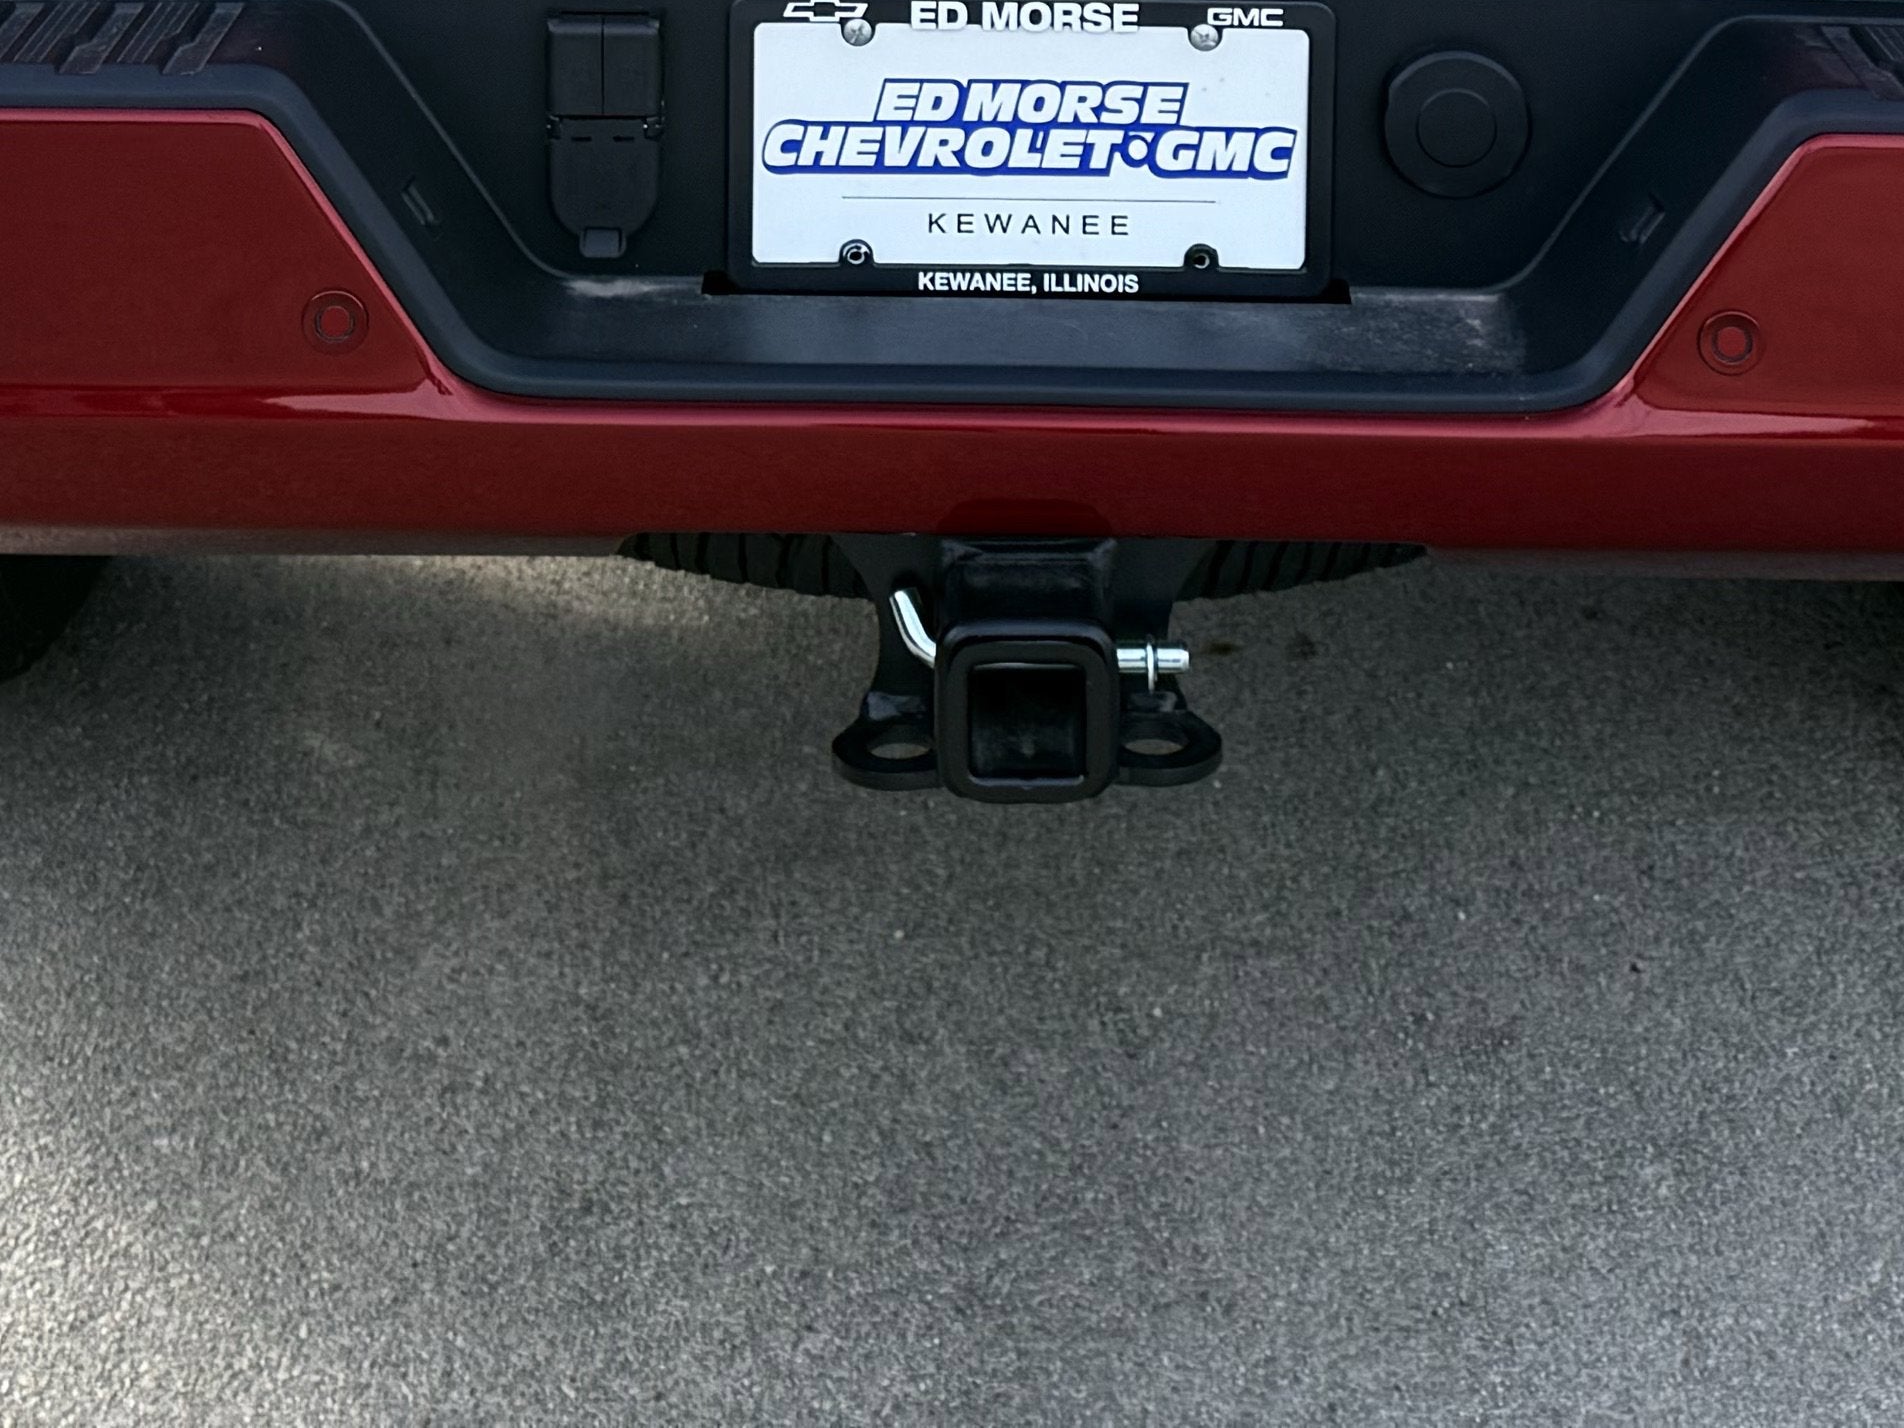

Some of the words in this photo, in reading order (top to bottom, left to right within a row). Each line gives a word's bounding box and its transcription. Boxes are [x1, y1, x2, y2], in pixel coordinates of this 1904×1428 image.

[910, 0, 968, 30] ED
[981, 1, 1140, 33] MORSE
[1207, 7, 1284, 27] GMC
[875, 81, 960, 122] ED
[962, 82, 1185, 125] MORSE
[927, 212, 1131, 236] KEWANEE
[917, 270, 1037, 294] KEWANEE,
[1043, 272, 1140, 294] ILLINOIS
